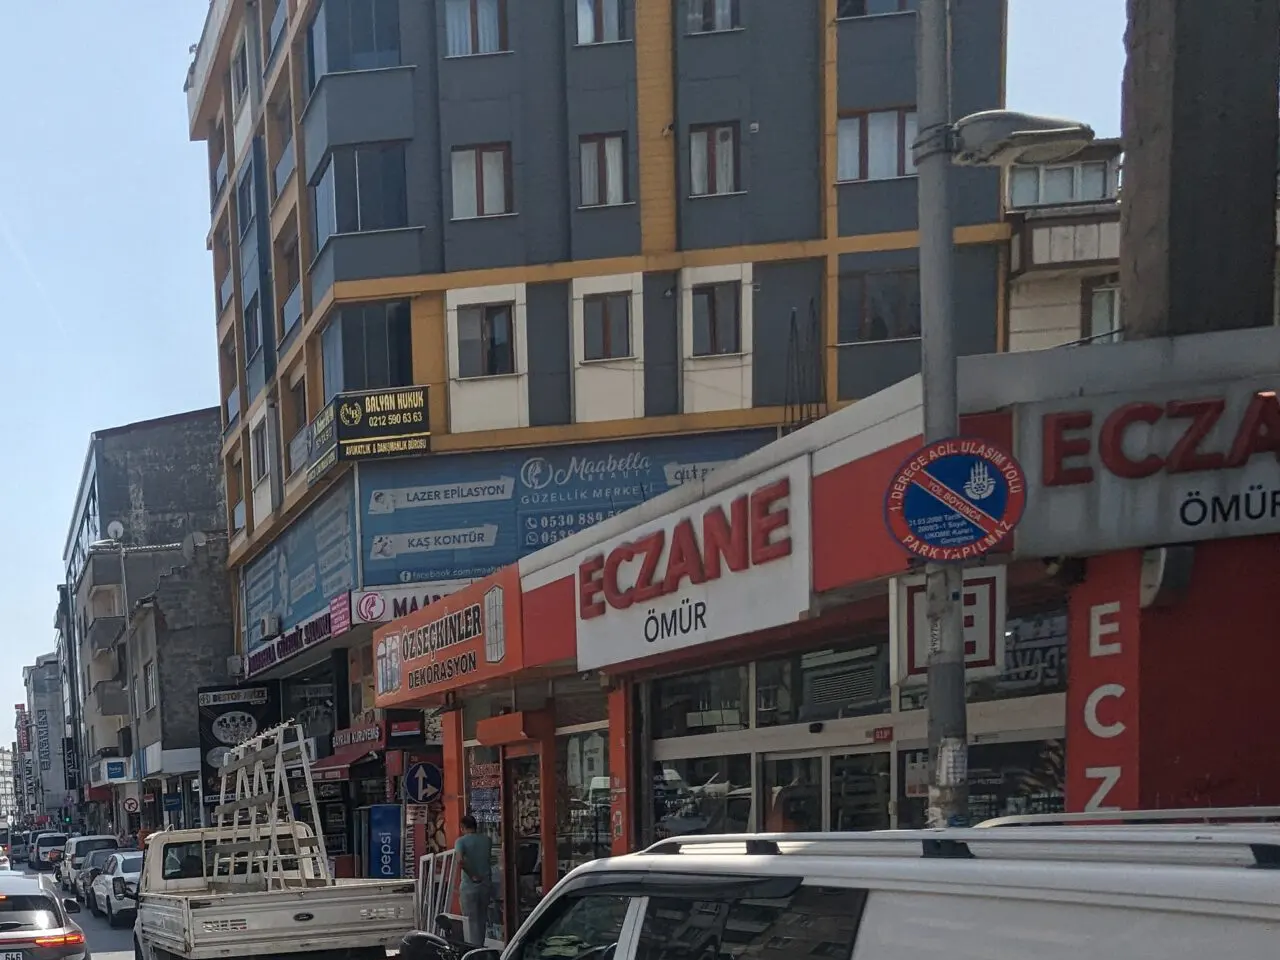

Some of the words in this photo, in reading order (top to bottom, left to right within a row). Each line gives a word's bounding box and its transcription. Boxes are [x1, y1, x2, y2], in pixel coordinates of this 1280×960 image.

[365, 393, 395, 413] BALYAN
[397, 390, 424, 409] HUKUK
[368, 416, 387, 427] 0212
[388, 414, 401, 425] 590
[402, 413, 412, 423] 63
[413, 411, 423, 422] 63
[554, 452, 651, 485] Maabella
[891, 455, 928, 498] DERECE
[1002, 461, 1023, 494] YOLU
[406, 491, 441, 502] LAZER
[443, 484, 505, 500] EPİLASYON
[521, 489, 588, 505] GÜZELLİK
[927, 481, 946, 497] YOL
[943, 492, 982, 521] BOYUNCA
[540, 514, 574, 529] 0530
[902, 535, 940, 559] PARK
[943, 520, 1013, 560] YAPILMAZ
[407, 536, 431, 550] KAŞ
[434, 532, 485, 546] KONTÜR
[579, 476, 793, 621] ECZANE
[417, 603, 482, 661] SEÇKİNLER
[644, 598, 707, 643] ÖMÜR
[408, 651, 477, 689] DEKORASYON
[378, 832, 394, 875] pepsi
